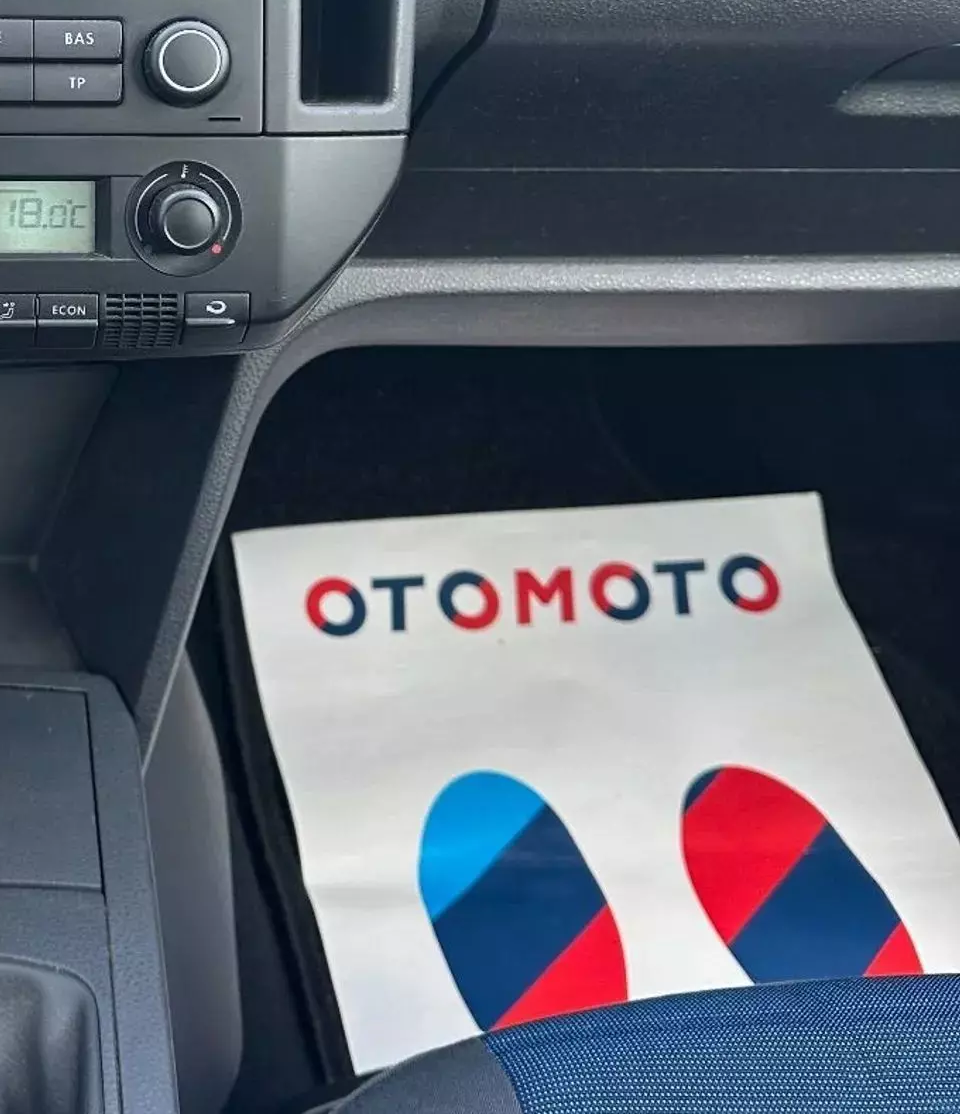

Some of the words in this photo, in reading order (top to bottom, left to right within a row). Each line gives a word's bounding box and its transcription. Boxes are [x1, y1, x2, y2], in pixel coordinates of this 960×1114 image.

[64, 32, 95, 45] BAS
[68, 76, 86, 89] TP
[52, 304, 86, 316] ECON
[305, 553, 782, 637] OTOMOTO
